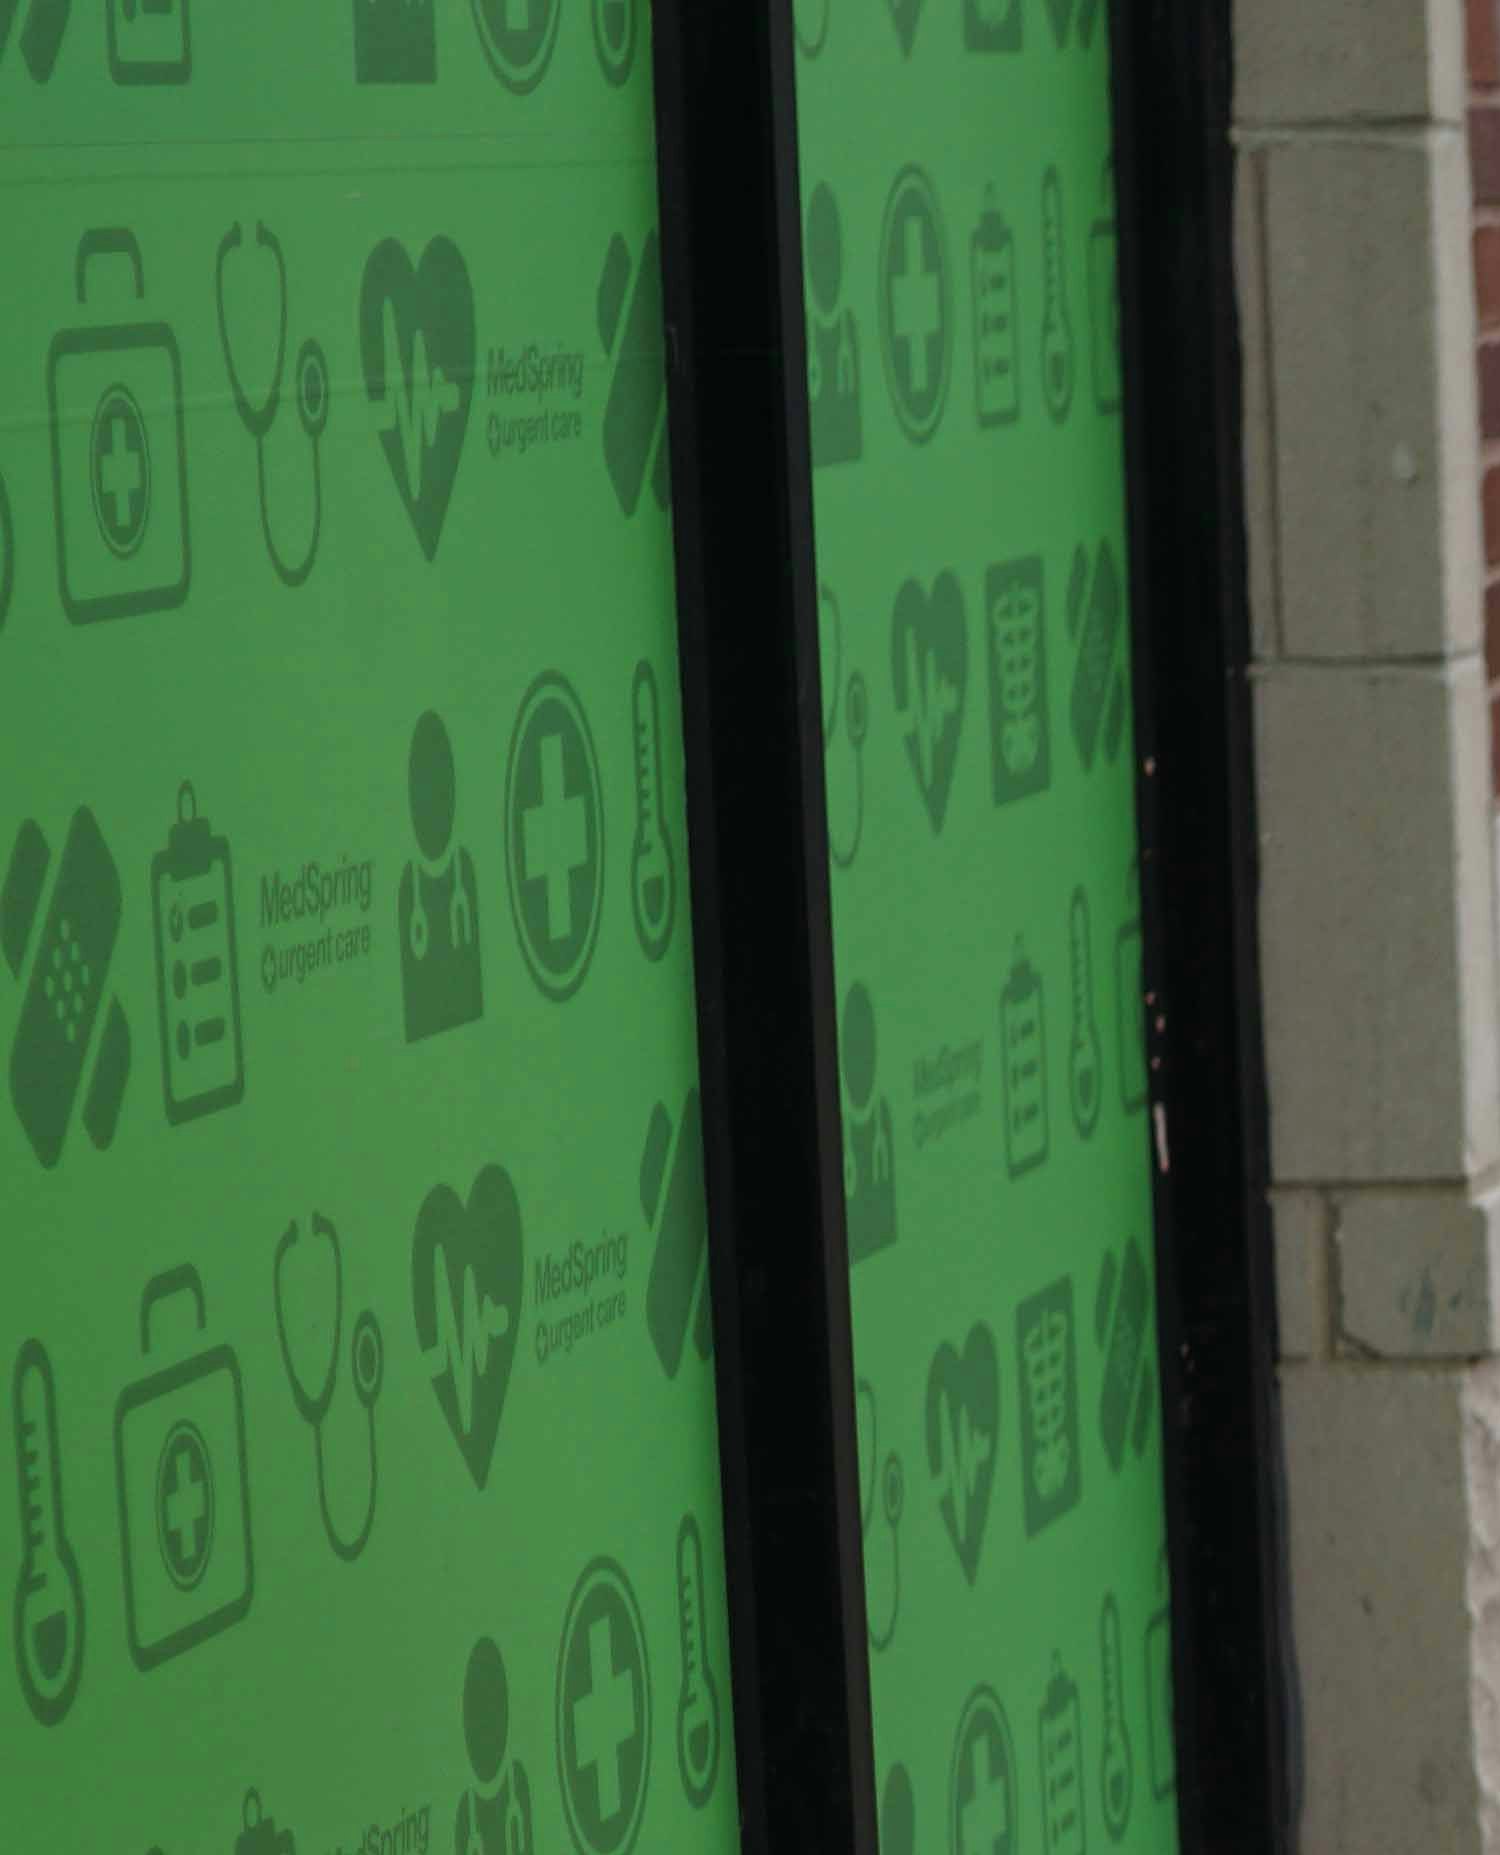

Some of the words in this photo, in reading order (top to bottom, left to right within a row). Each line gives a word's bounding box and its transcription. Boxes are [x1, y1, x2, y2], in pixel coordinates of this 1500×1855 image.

[488, 346, 584, 404] MedSpring
[261, 853, 371, 929] MedSpring
[279, 930, 333, 985] urgent
[335, 926, 369, 962] care
[535, 1229, 628, 1305] MedSpring
[550, 1301, 596, 1354] urgent
[597, 1290, 626, 1328] care
